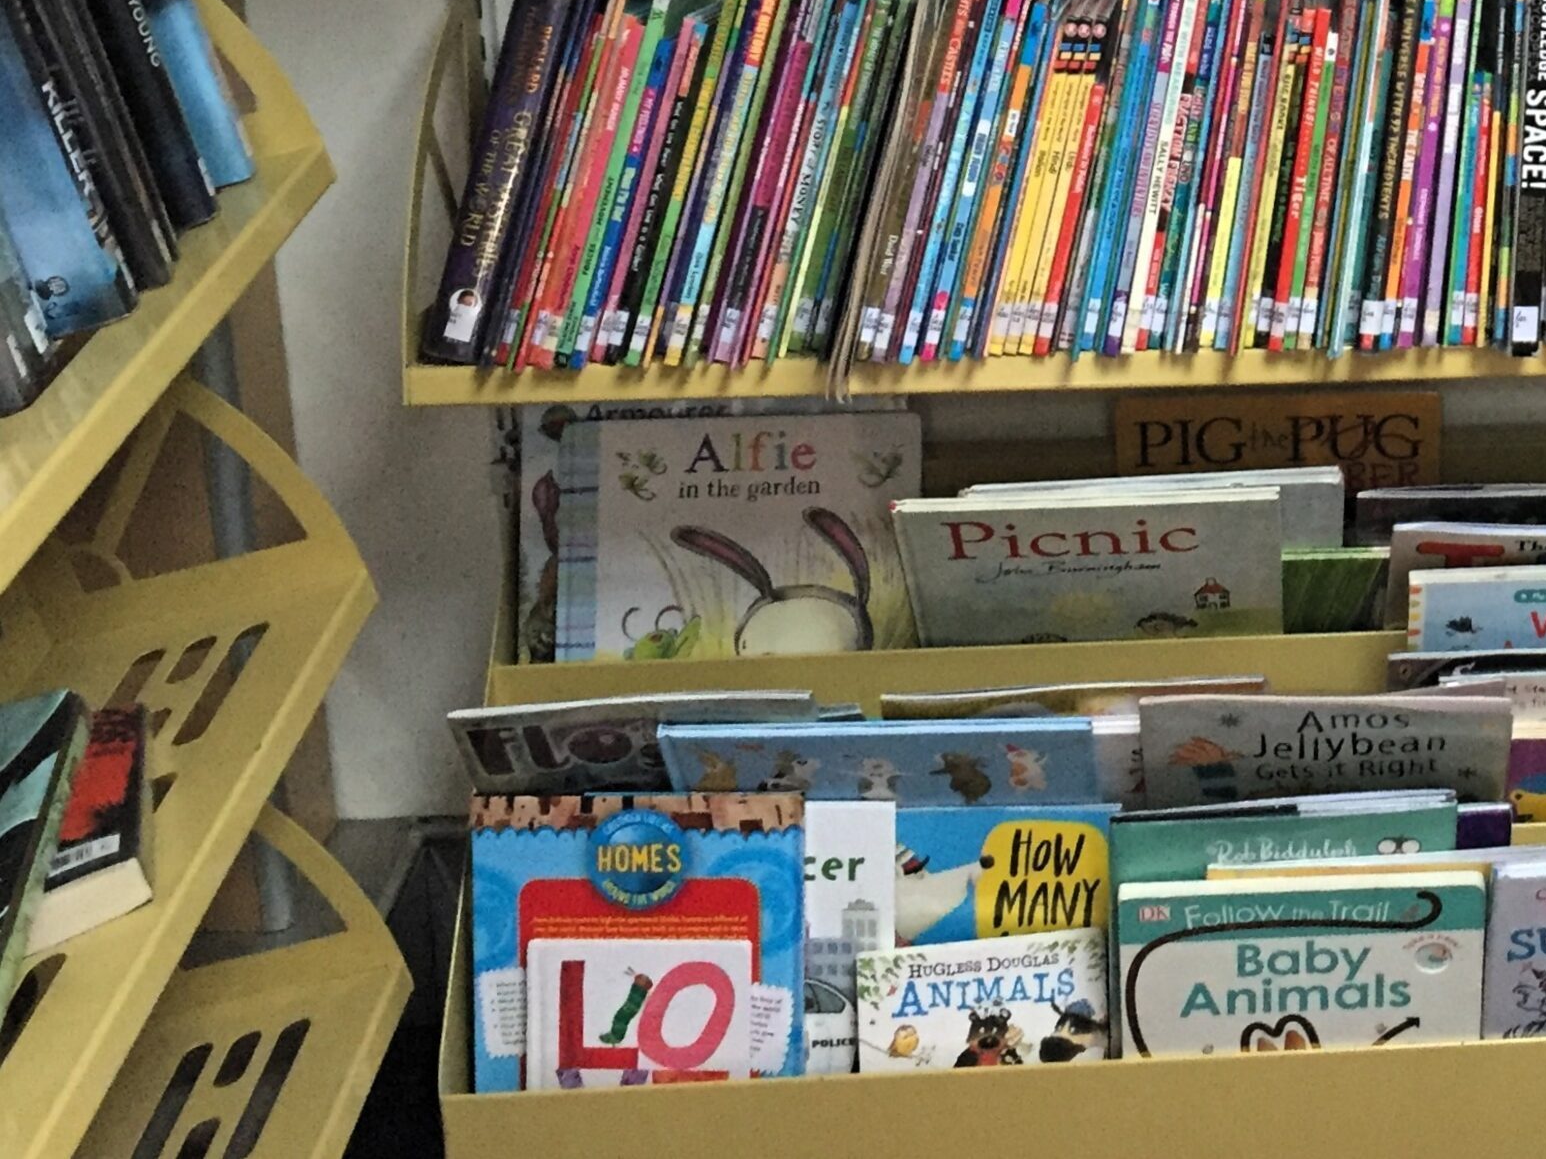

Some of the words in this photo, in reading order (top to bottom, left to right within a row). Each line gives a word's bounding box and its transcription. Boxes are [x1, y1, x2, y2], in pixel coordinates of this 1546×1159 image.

[1157, 140, 1168, 173] SALLY
[684, 431, 818, 473] Alfie
[1134, 415, 1247, 468] PIG
[1287, 414, 1424, 463] PUG
[679, 481, 699, 499] in
[707, 479, 738, 498] the
[747, 476, 820, 501] garden
[940, 519, 1200, 561] Picnic
[1296, 710, 1410, 733] Amos
[1252, 734, 1447, 763] Jellybean
[1254, 762, 1310, 780] Gets
[1358, 758, 1440, 779] Right
[597, 843, 682, 874] HOMES
[1009, 828, 1085, 878] HOW
[993, 879, 1100, 929] MANY
[1140, 908, 1170, 921] DK
[1184, 903, 1286, 930] Follow
[1328, 900, 1391, 921] Trail
[908, 959, 982, 979] HUGLESS
[986, 953, 1060, 972] DOUGLAS
[1237, 940, 1372, 982] Baby
[892, 967, 1076, 1018] ANIMALS
[1179, 973, 1412, 1018] Animals
